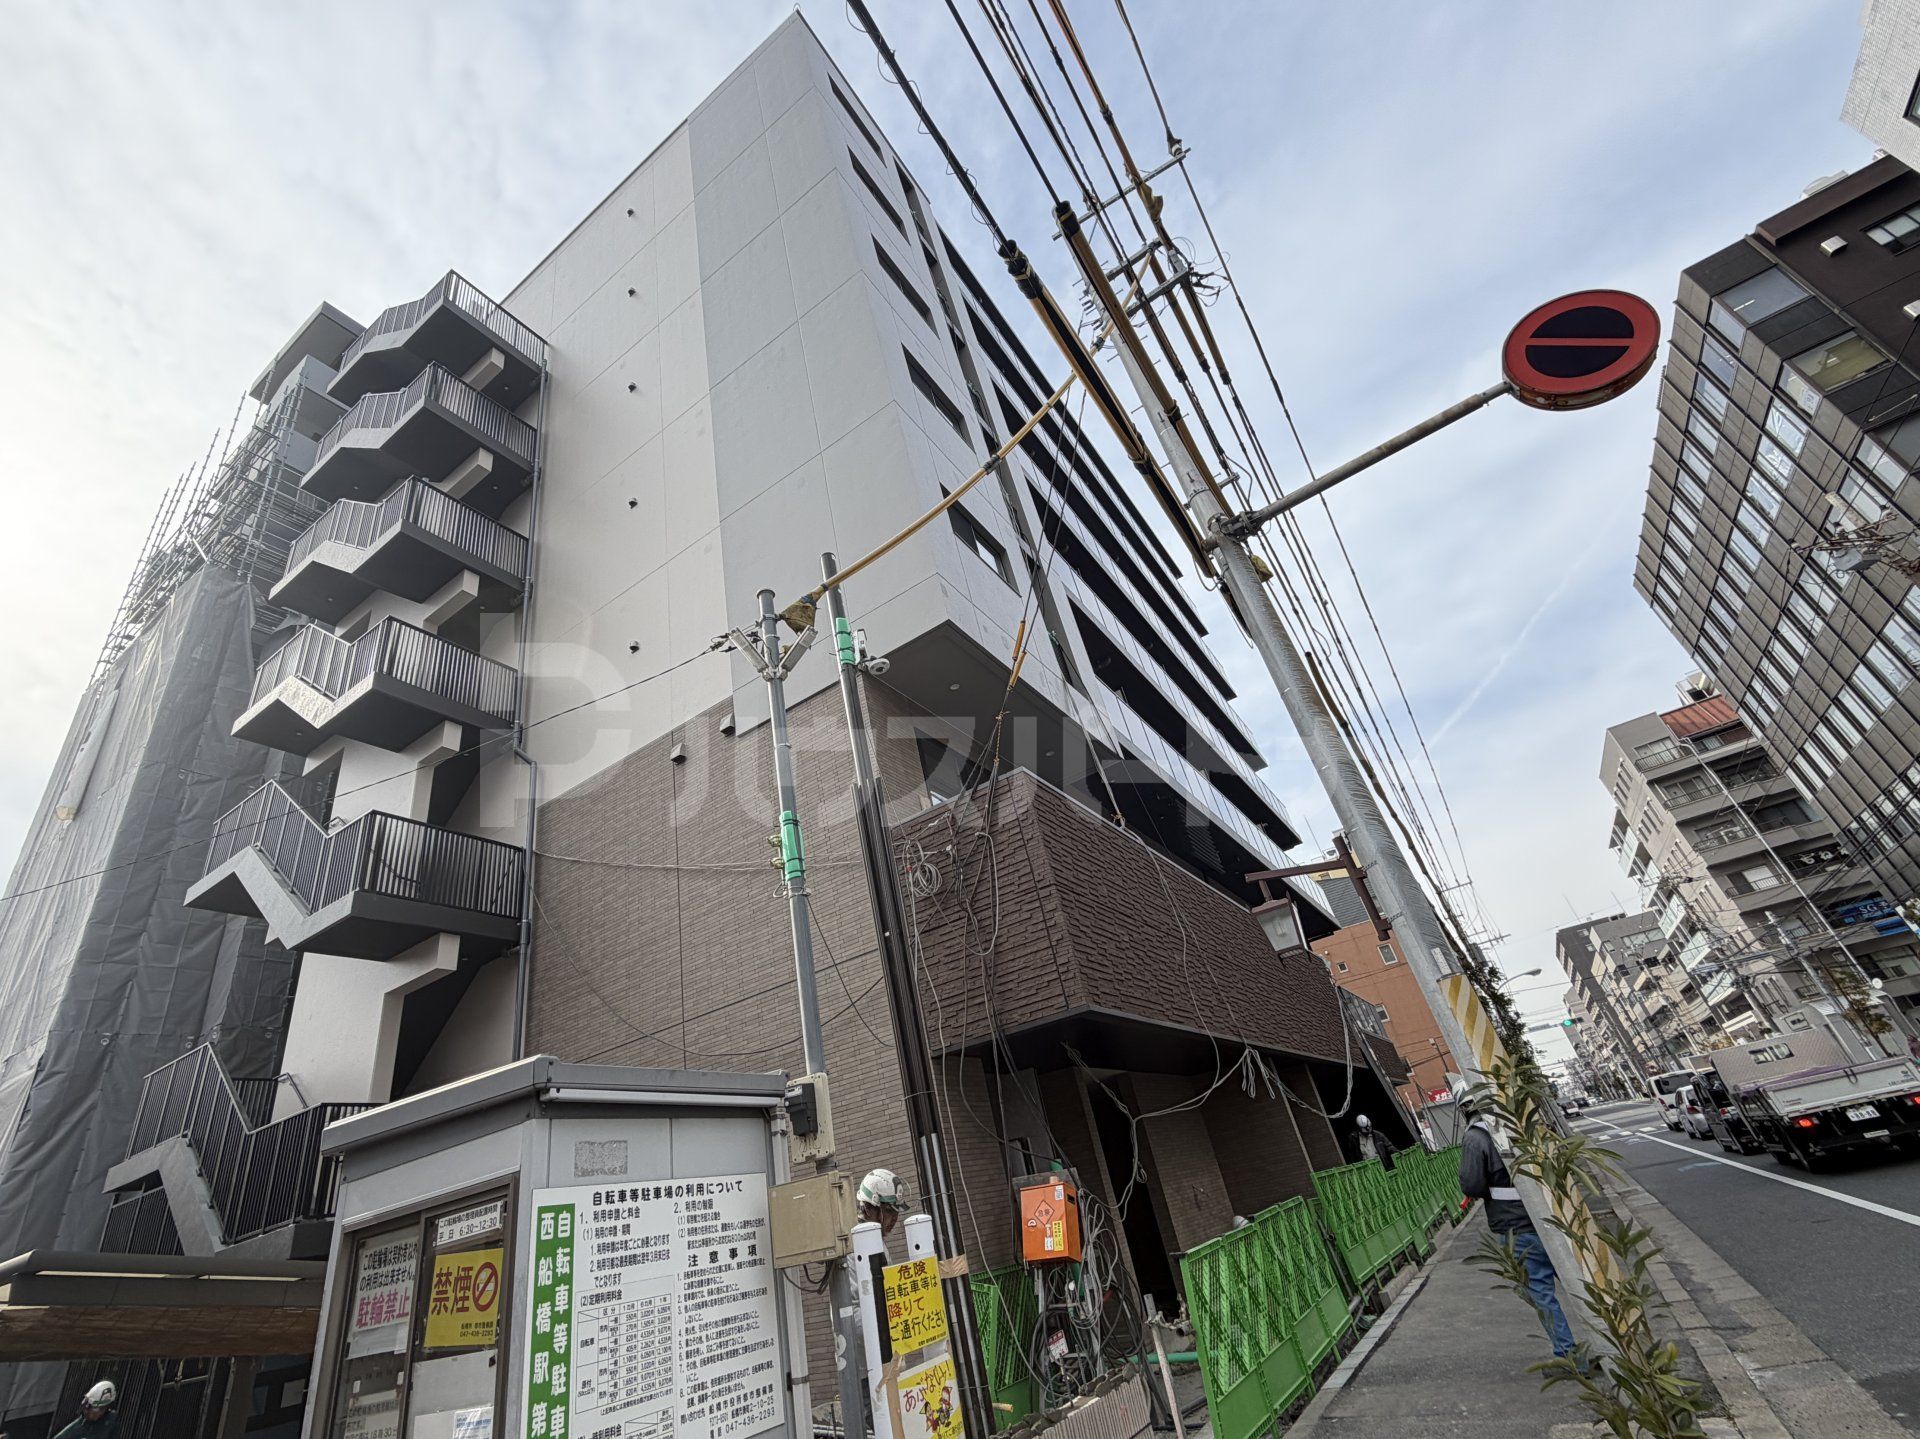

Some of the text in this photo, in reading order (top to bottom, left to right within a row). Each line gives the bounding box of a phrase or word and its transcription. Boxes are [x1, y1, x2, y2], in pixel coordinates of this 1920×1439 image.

[592, 1179, 743, 1206] 自転車等駐車場の利用について
[593, 1206, 640, 1223] 利用申請と料金
[439, 1229, 454, 1242] 平日
[688, 1244, 757, 1267] 注意事項
[898, 1261, 927, 1281] 危険
[431, 1266, 473, 1316] 禁煙
[886, 1274, 937, 1301] 自転車等は
[355, 1287, 409, 1329] 駐輪禁止
[888, 1296, 924, 1322] 降りて
[531, 1212, 555, 1438] 西船橋駅第
[891, 1309, 945, 1342] ご通行ください
[726, 1407, 775, 1433] 047-436-2293
